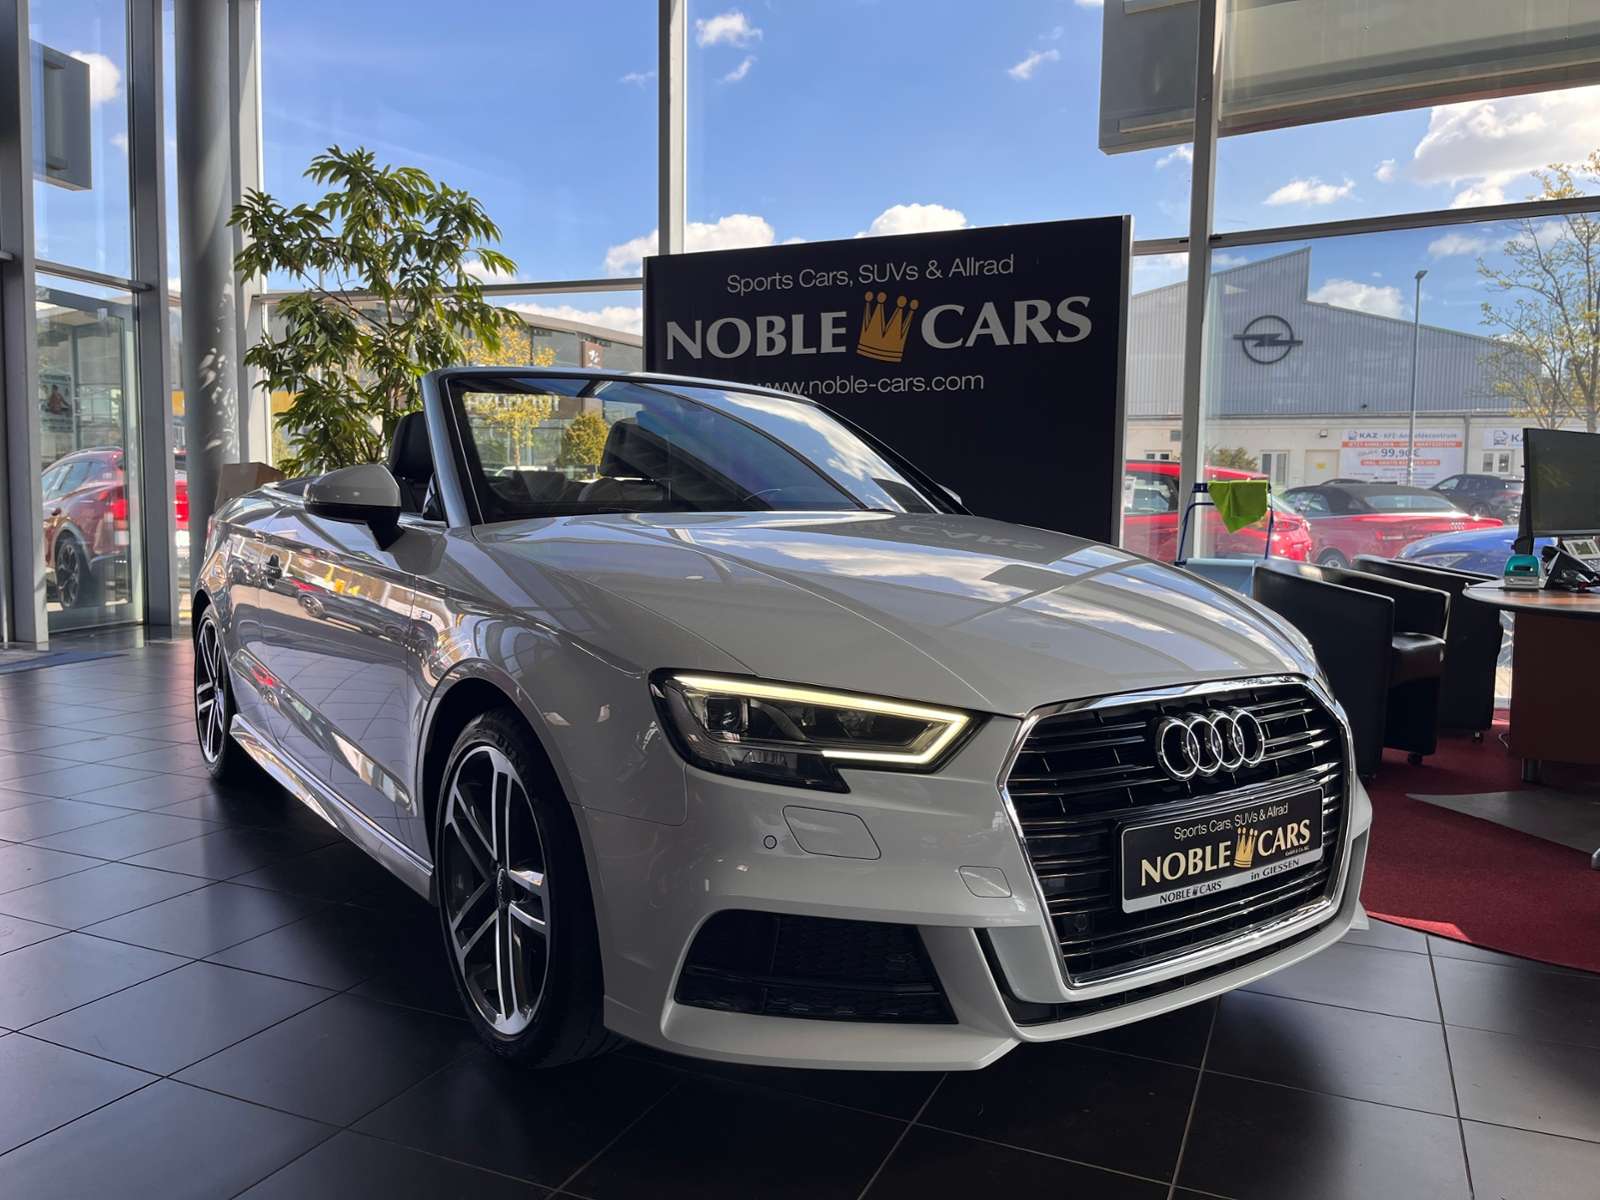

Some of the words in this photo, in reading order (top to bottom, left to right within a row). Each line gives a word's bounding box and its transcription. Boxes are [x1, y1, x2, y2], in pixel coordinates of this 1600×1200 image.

[727, 272, 794, 296] Sports
[799, 268, 854, 288] Cars,
[858, 262, 919, 284] SUVs
[926, 259, 943, 279] &
[948, 254, 1015, 277] Allrad
[665, 311, 847, 360] NOBLE
[921, 295, 1093, 349] CARS
[755, 373, 985, 395] ww.noble-cars.com
[1359, 432, 1378, 440] KAZ
[1174, 824, 1207, 841] Sports
[1208, 818, 1233, 834] Cars,
[1234, 812, 1258, 828] SUVs
[1259, 809, 1266, 821] &
[1266, 802, 1289, 818] Allrad
[1140, 840, 1232, 887] NOBLE
[1257, 819, 1311, 857] CARS
[1251, 869, 1260, 881] in
[1262, 858, 1300, 876] GIESSEN
[1159, 889, 1191, 904] NOBLE
[1199, 880, 1222, 895] CARS
